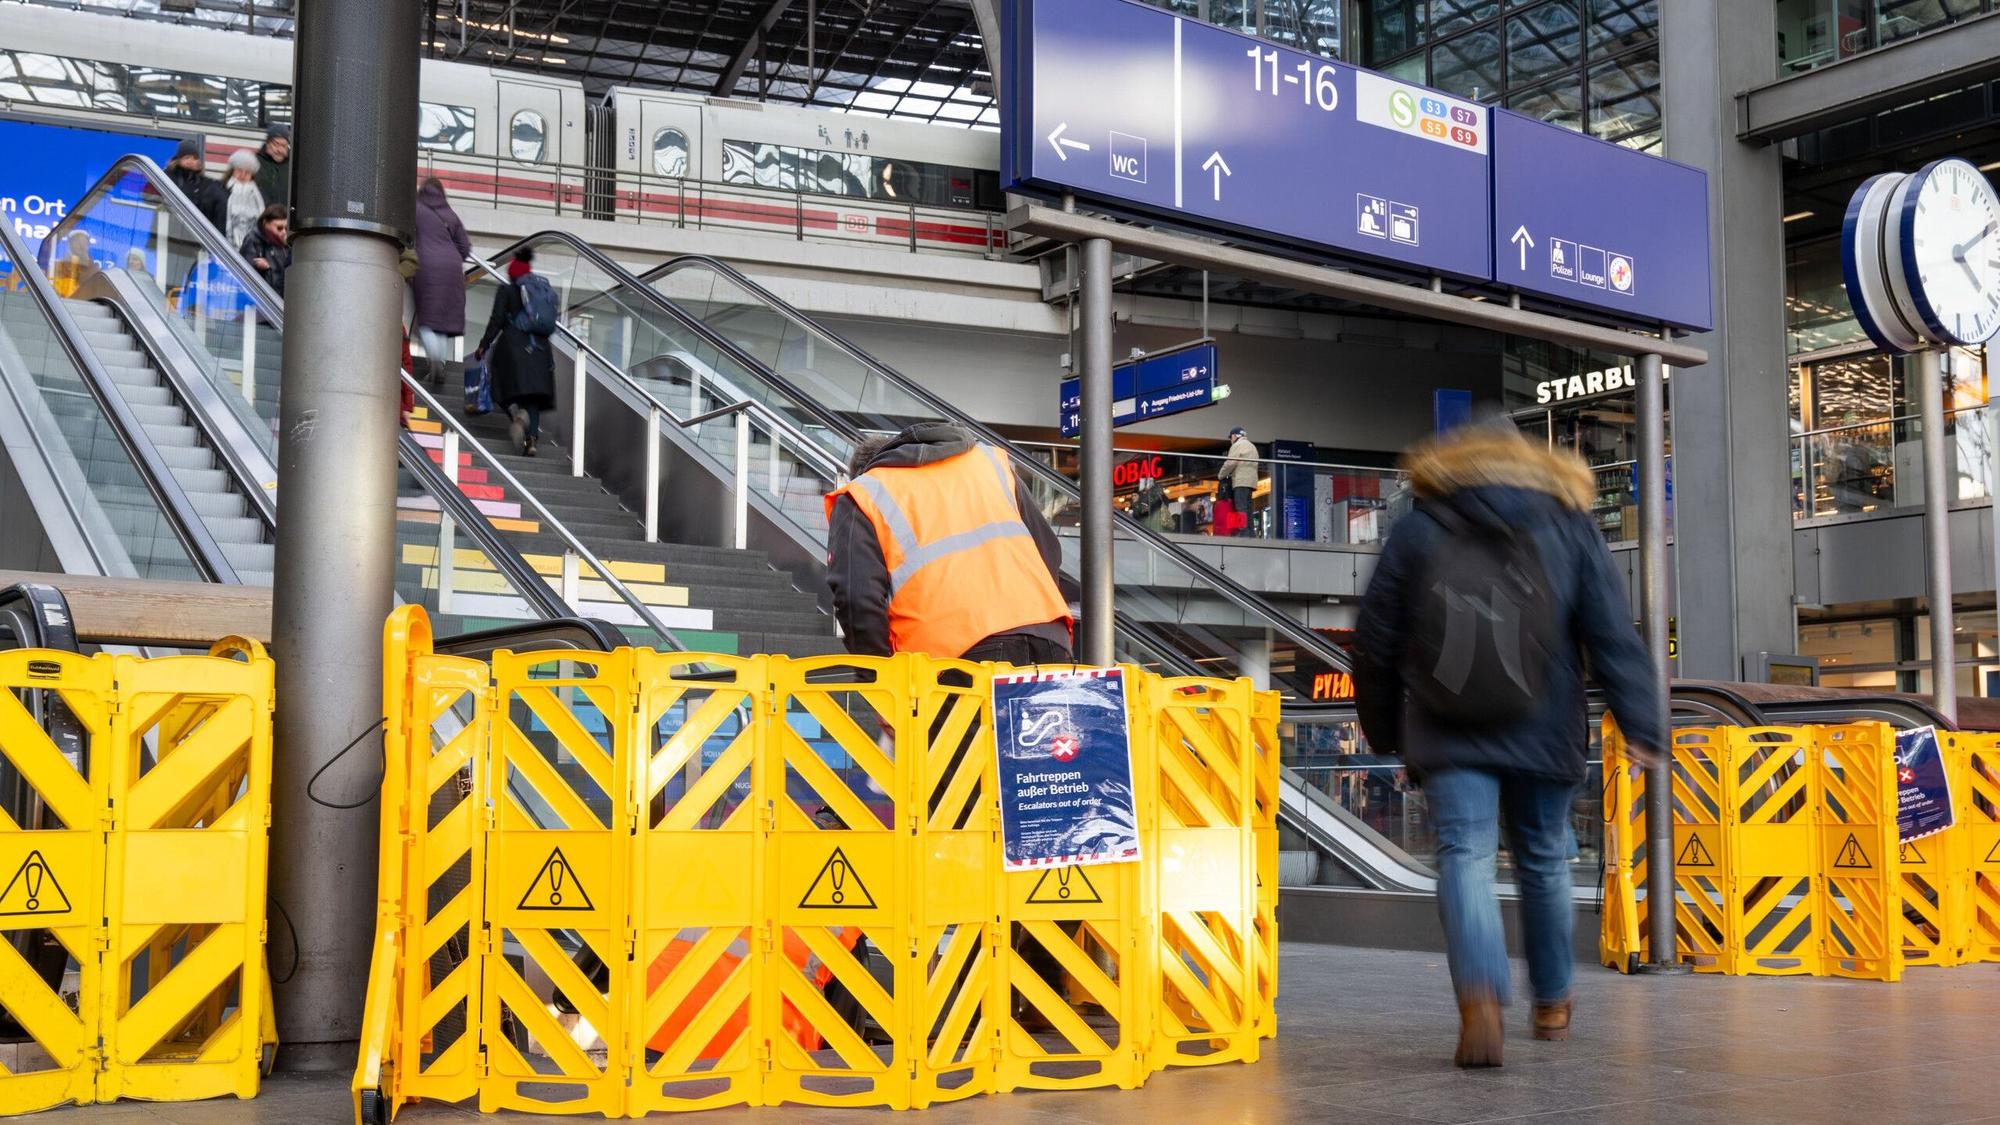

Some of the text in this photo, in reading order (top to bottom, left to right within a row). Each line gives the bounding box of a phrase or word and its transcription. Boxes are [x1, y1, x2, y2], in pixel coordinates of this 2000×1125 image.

[1247, 45, 1338, 111] 11-16
[1426, 100, 1441, 115] S3
[1457, 109, 1471, 123] S7
[1426, 121, 1442, 136] S5
[1457, 130, 1472, 144] S9
[1112, 153, 1138, 175] WC
[23, 195, 66, 217] Ort
[14, 217, 59, 239] ha
[1552, 263, 1573, 277] Polizei
[1581, 270, 1605, 285] Lounge
[1536, 364, 1669, 404] STARBU
[1113, 456, 1162, 486] OBAG
[1016, 771, 1081, 784] Fahrtreppen
[1017, 782, 1089, 798] außer Betrieb
[1018, 800, 1057, 811] Escalators
[1058, 799, 1071, 808] out
[1072, 798, 1081, 808] of
